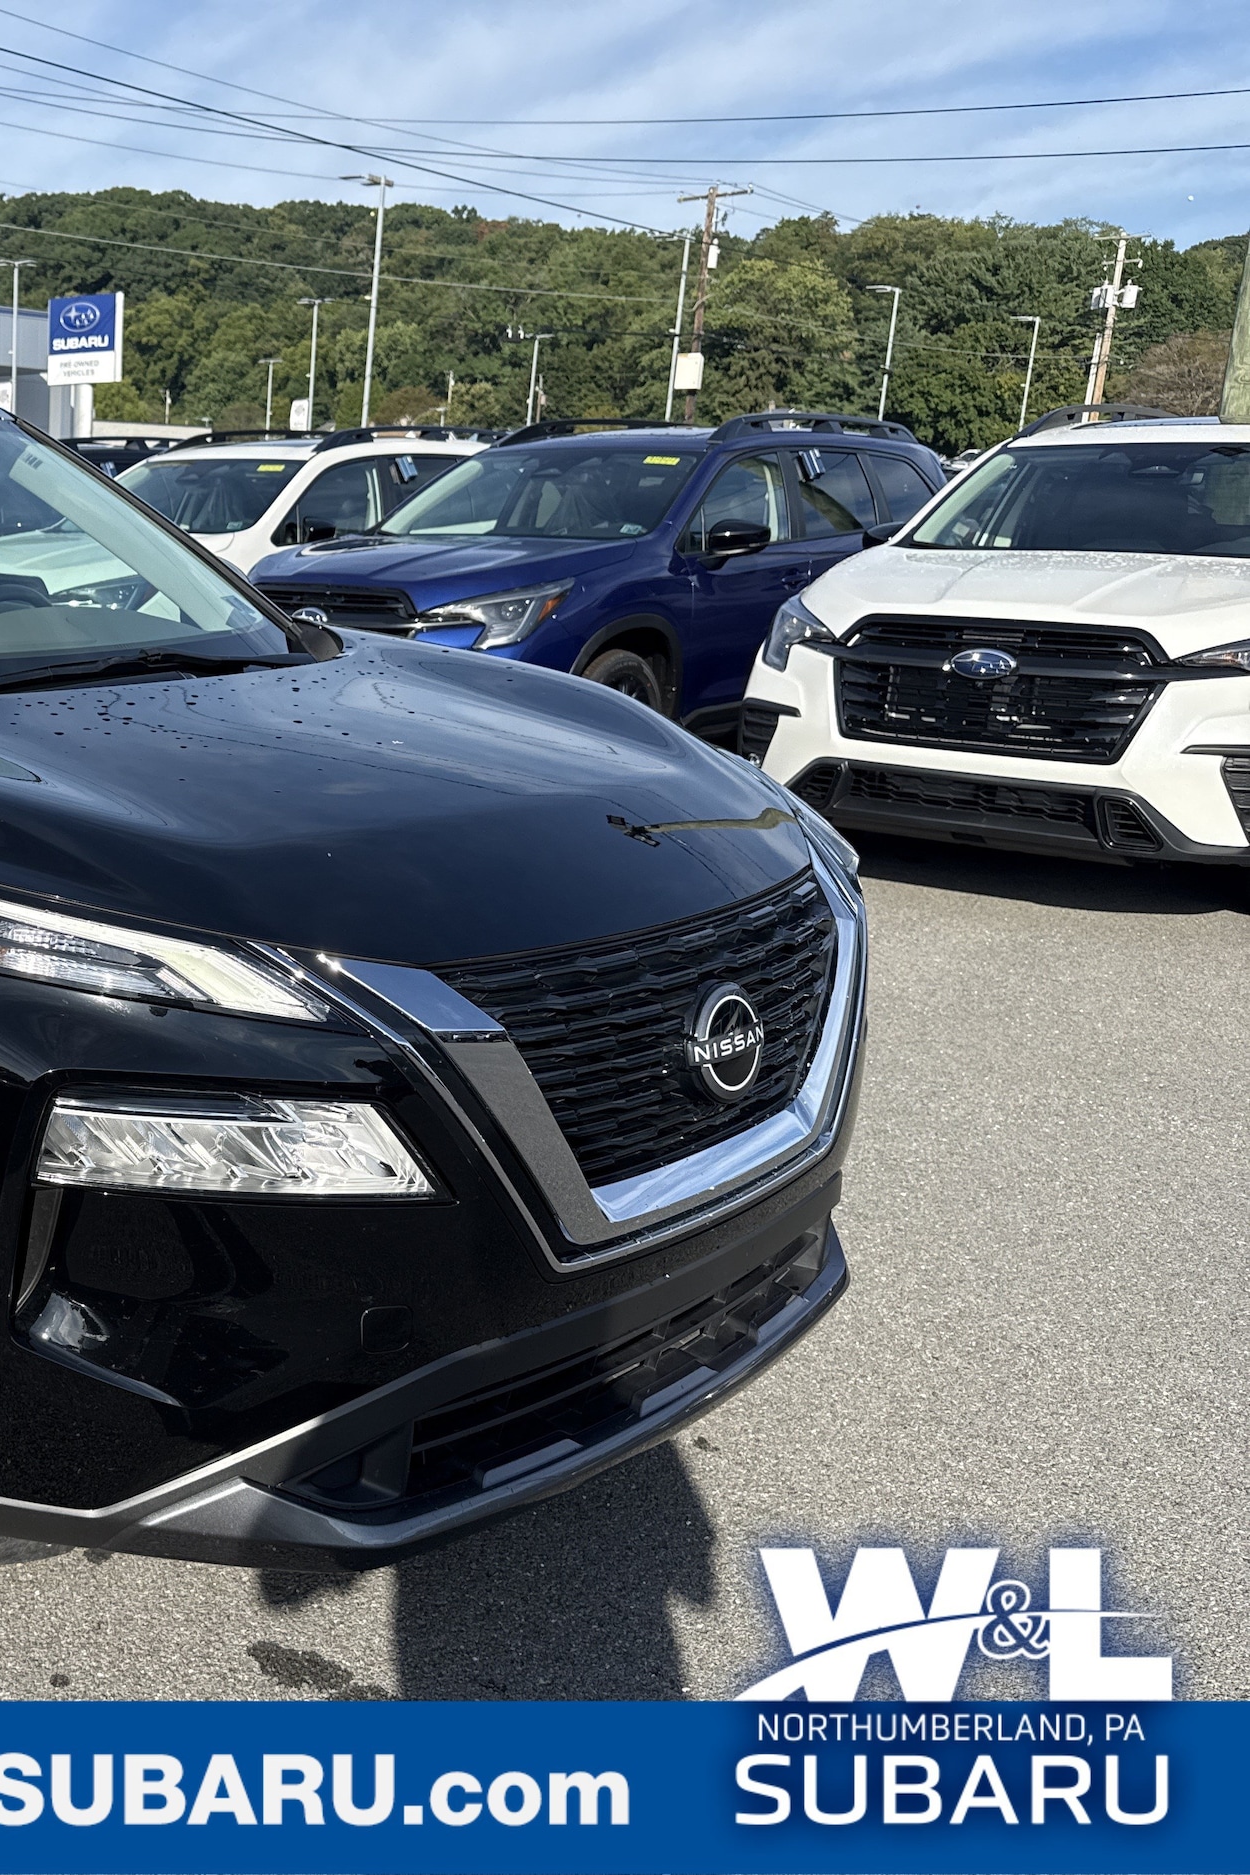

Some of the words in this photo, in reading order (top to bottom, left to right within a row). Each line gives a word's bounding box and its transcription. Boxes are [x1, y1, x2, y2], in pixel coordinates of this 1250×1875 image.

[52, 334, 109, 351] SUBARU
[63, 369, 95, 377] VEHICLES
[694, 1026, 764, 1062] NISSAN
